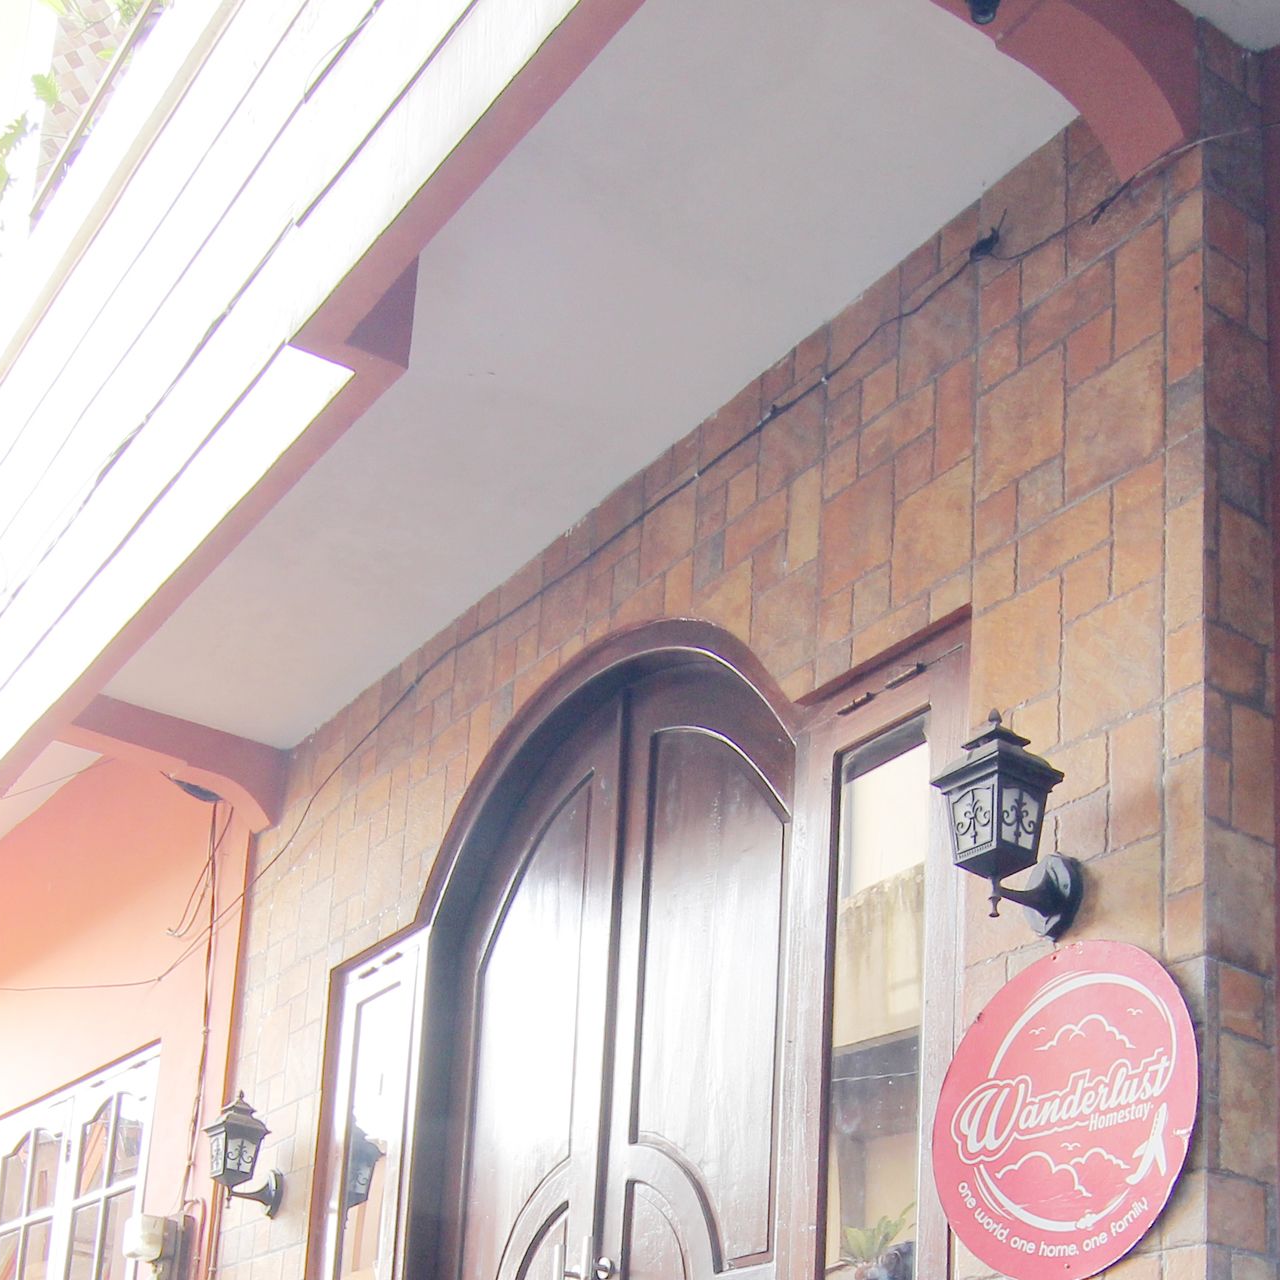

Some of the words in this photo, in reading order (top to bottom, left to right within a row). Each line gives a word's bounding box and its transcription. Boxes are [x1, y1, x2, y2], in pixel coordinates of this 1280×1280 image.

[960, 1056, 1169, 1153] Wanderlust
[1088, 1102, 1150, 1132] Homestay
[958, 1181, 977, 1209] one
[1010, 1235, 1036, 1254] one
[1082, 1231, 1108, 1252] one
[1110, 1196, 1150, 1237] family
